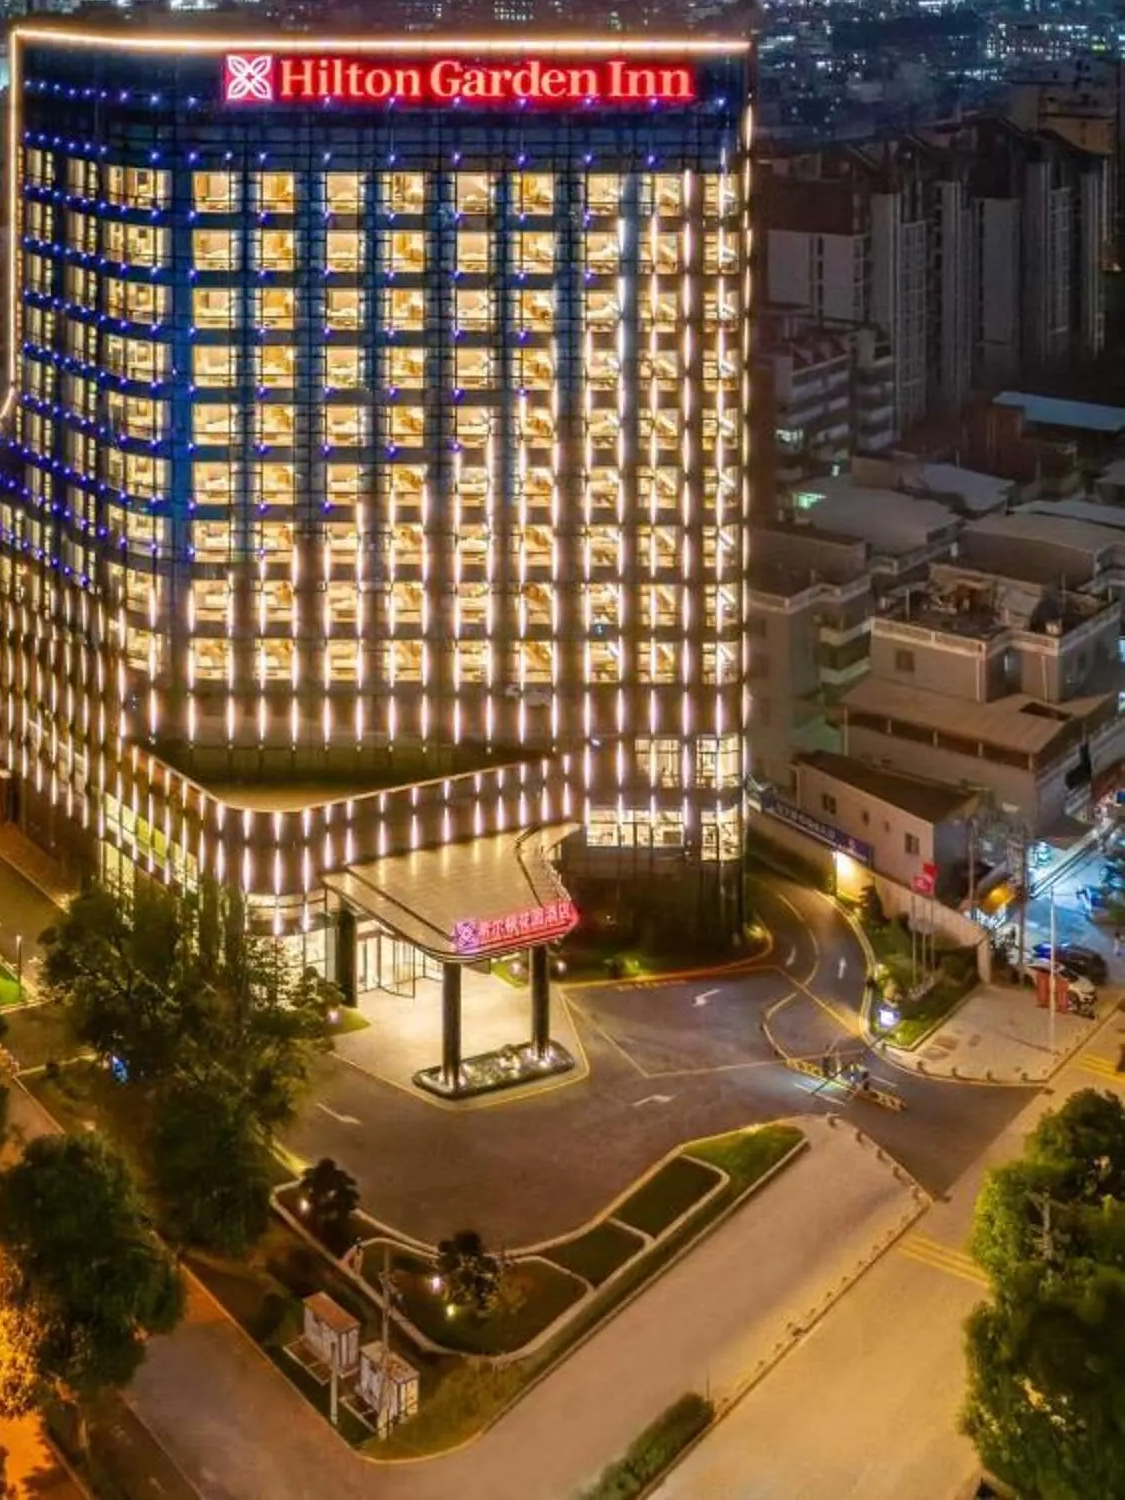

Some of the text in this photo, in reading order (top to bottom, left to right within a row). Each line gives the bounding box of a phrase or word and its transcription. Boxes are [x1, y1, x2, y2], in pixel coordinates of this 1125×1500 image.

[281, 59, 691, 98] Hilton Garden Inn
